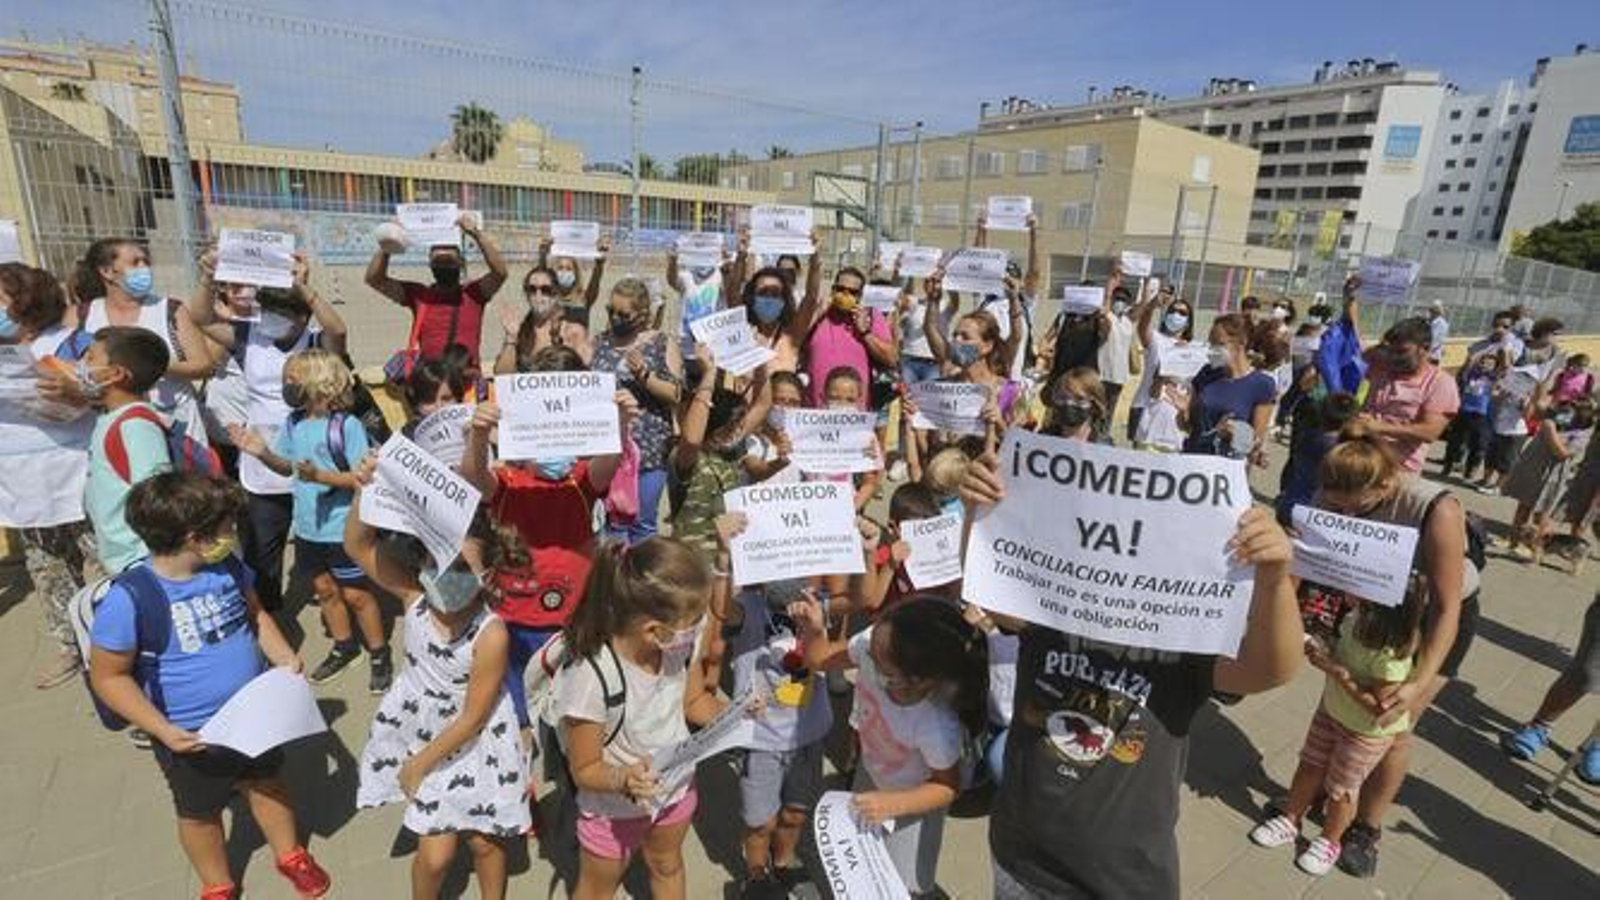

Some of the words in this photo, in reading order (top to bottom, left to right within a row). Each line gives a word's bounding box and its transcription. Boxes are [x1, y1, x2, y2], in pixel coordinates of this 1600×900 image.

[511, 374, 601, 394] ¡COMEDOR
[543, 395, 571, 413] YA!
[819, 429, 840, 443] YA!
[386, 444, 468, 508] ¡COMEDOR
[1012, 441, 1233, 507] ¡COMEDOR
[742, 484, 838, 507] ¡COMEDOR
[780, 508, 809, 528] YA!
[1306, 510, 1399, 544] ¡COMEDOR
[1076, 516, 1142, 557] YA!
[1329, 539, 1361, 557] YA!
[993, 538, 1128, 588] CONCILIACION
[1132, 574, 1235, 599] FAMILIAR
[993, 560, 1052, 590] Trabajar
[1056, 583, 1077, 598] no
[1080, 592, 1100, 605] es
[1104, 595, 1136, 610] una
[1141, 599, 1200, 620] opción
[1204, 608, 1224, 620] es
[1040, 598, 1068, 616] una
[1073, 606, 1160, 633] obligación
[838, 839, 859, 871] YA!
